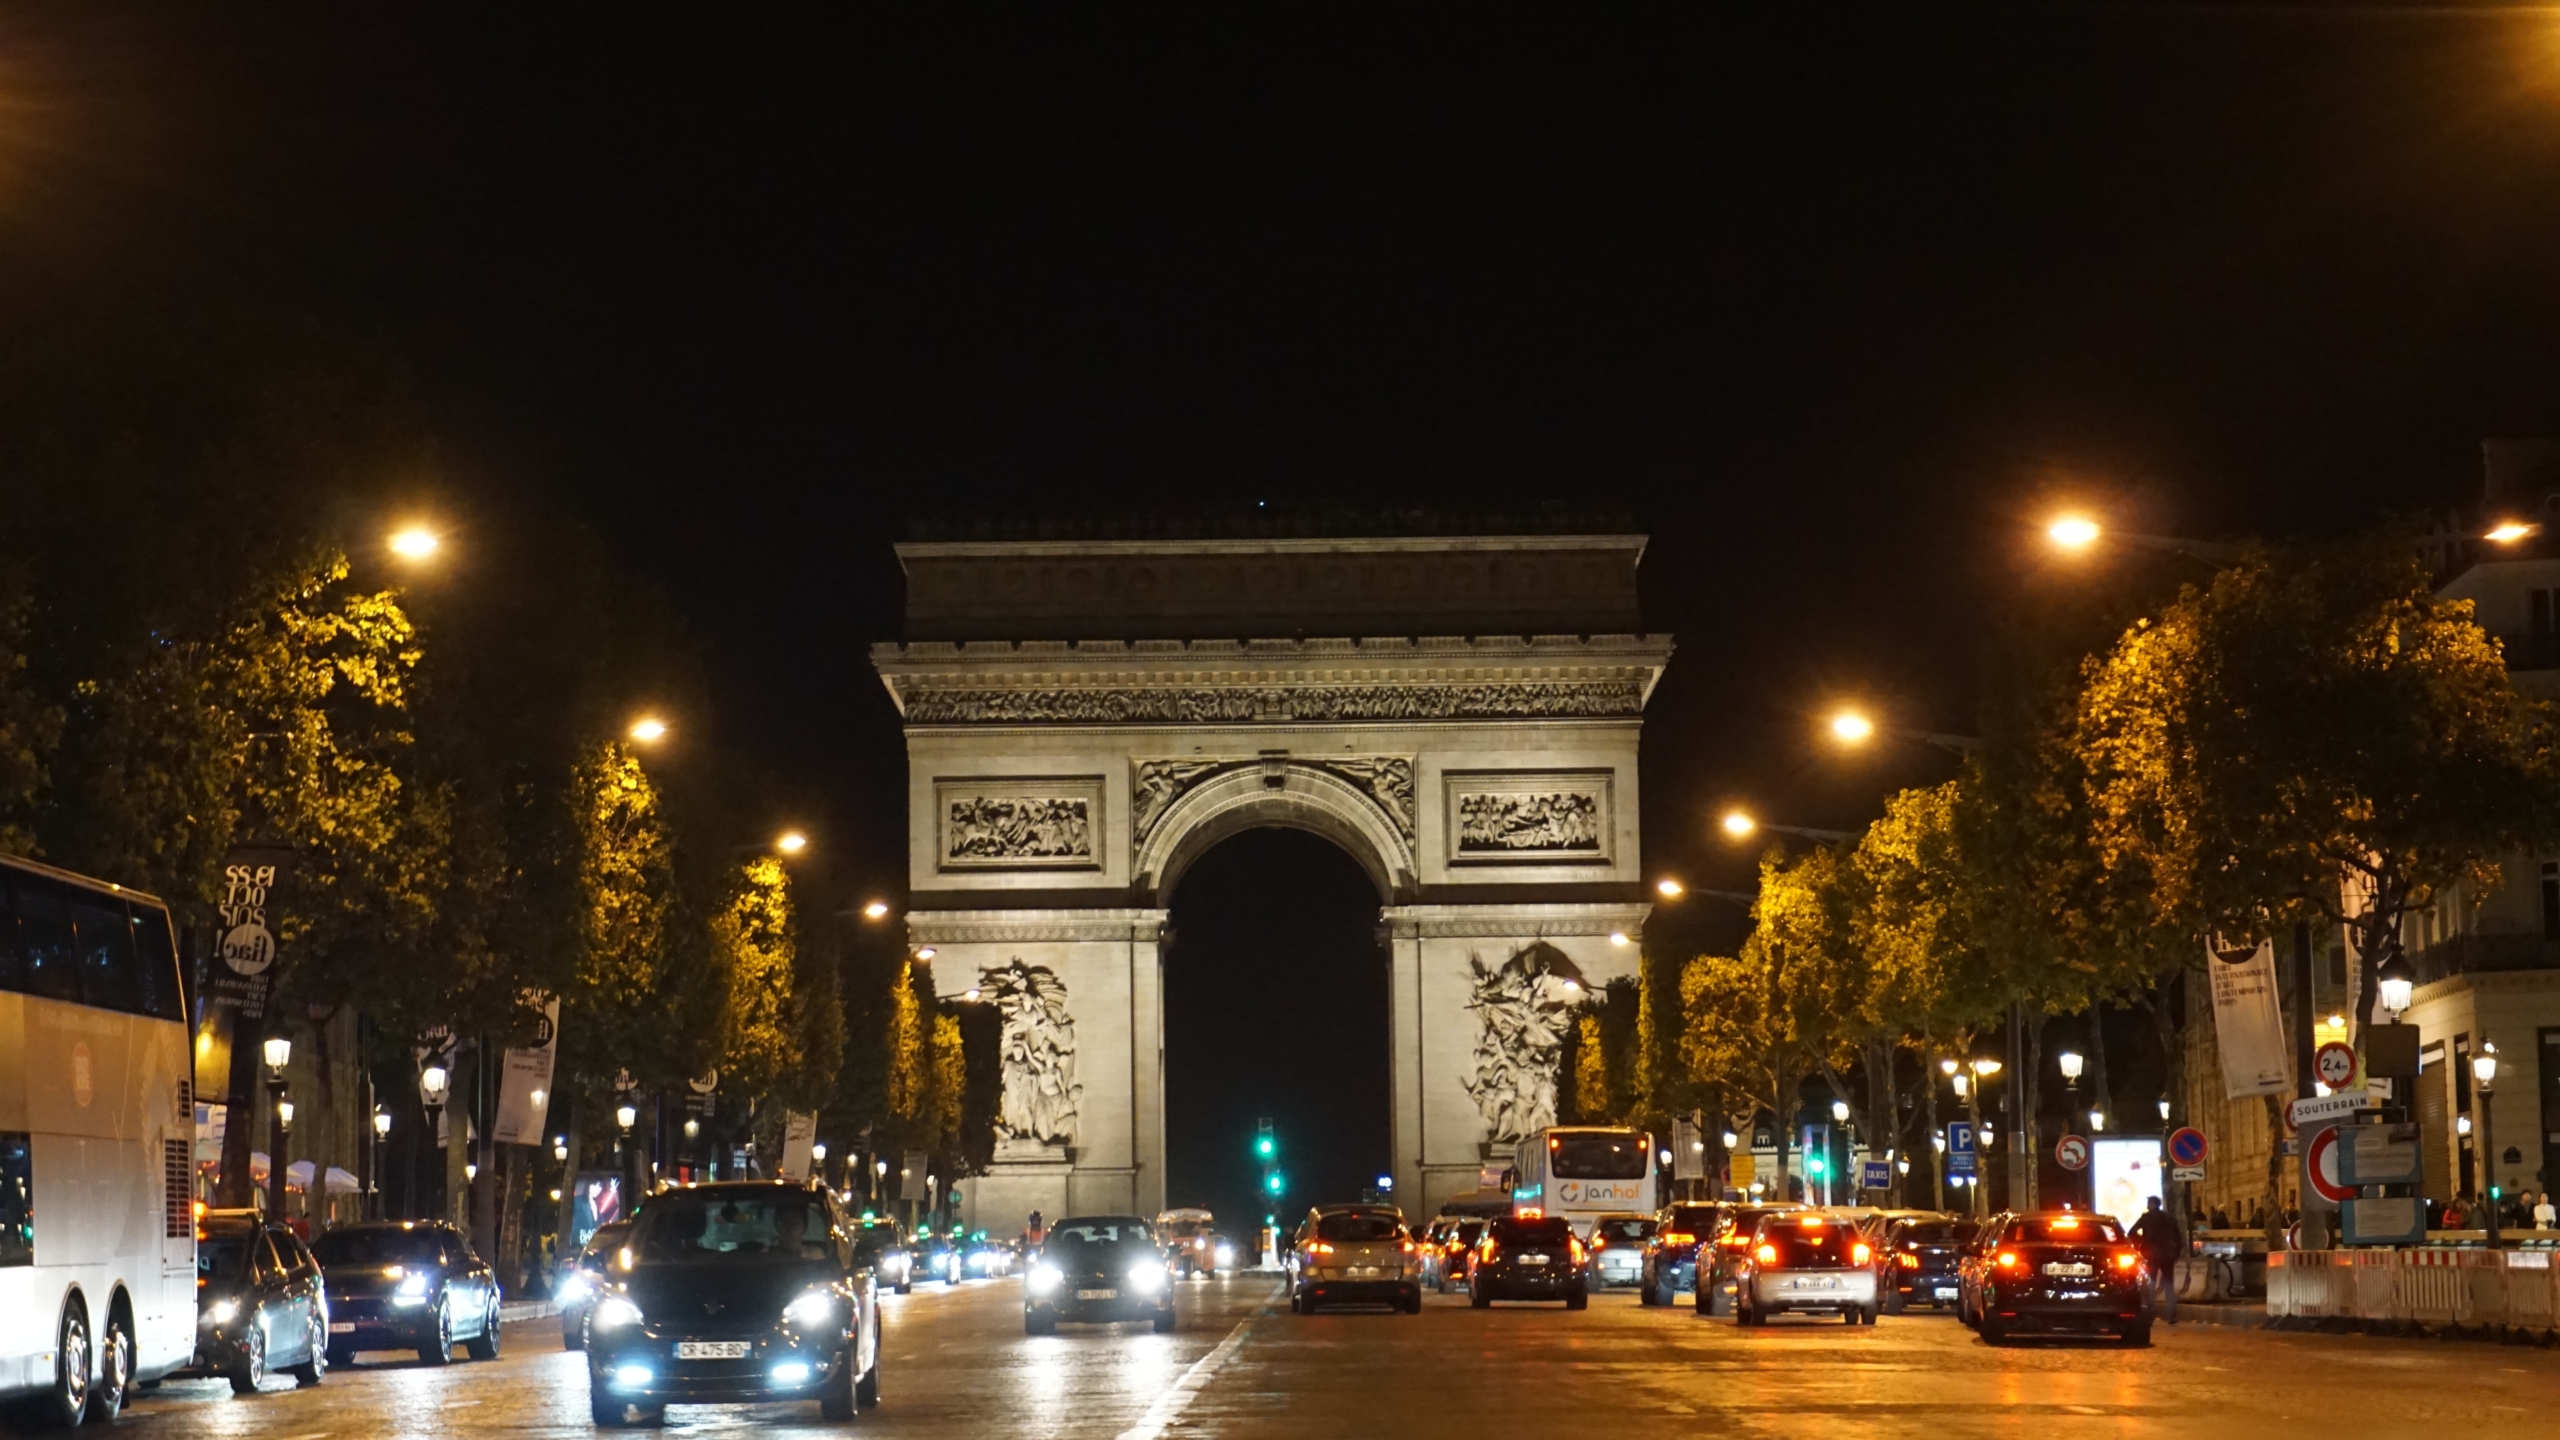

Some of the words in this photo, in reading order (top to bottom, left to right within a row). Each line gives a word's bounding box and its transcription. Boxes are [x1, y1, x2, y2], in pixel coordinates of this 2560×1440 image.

[2297, 1097, 2368, 1116] SOUTERRAIN
[1958, 1128, 1972, 1149] P
[1866, 1169, 1888, 1180] TAXIS
[1583, 1183, 1640, 1203] janhol
[682, 1343, 743, 1357] CR-475-BD
